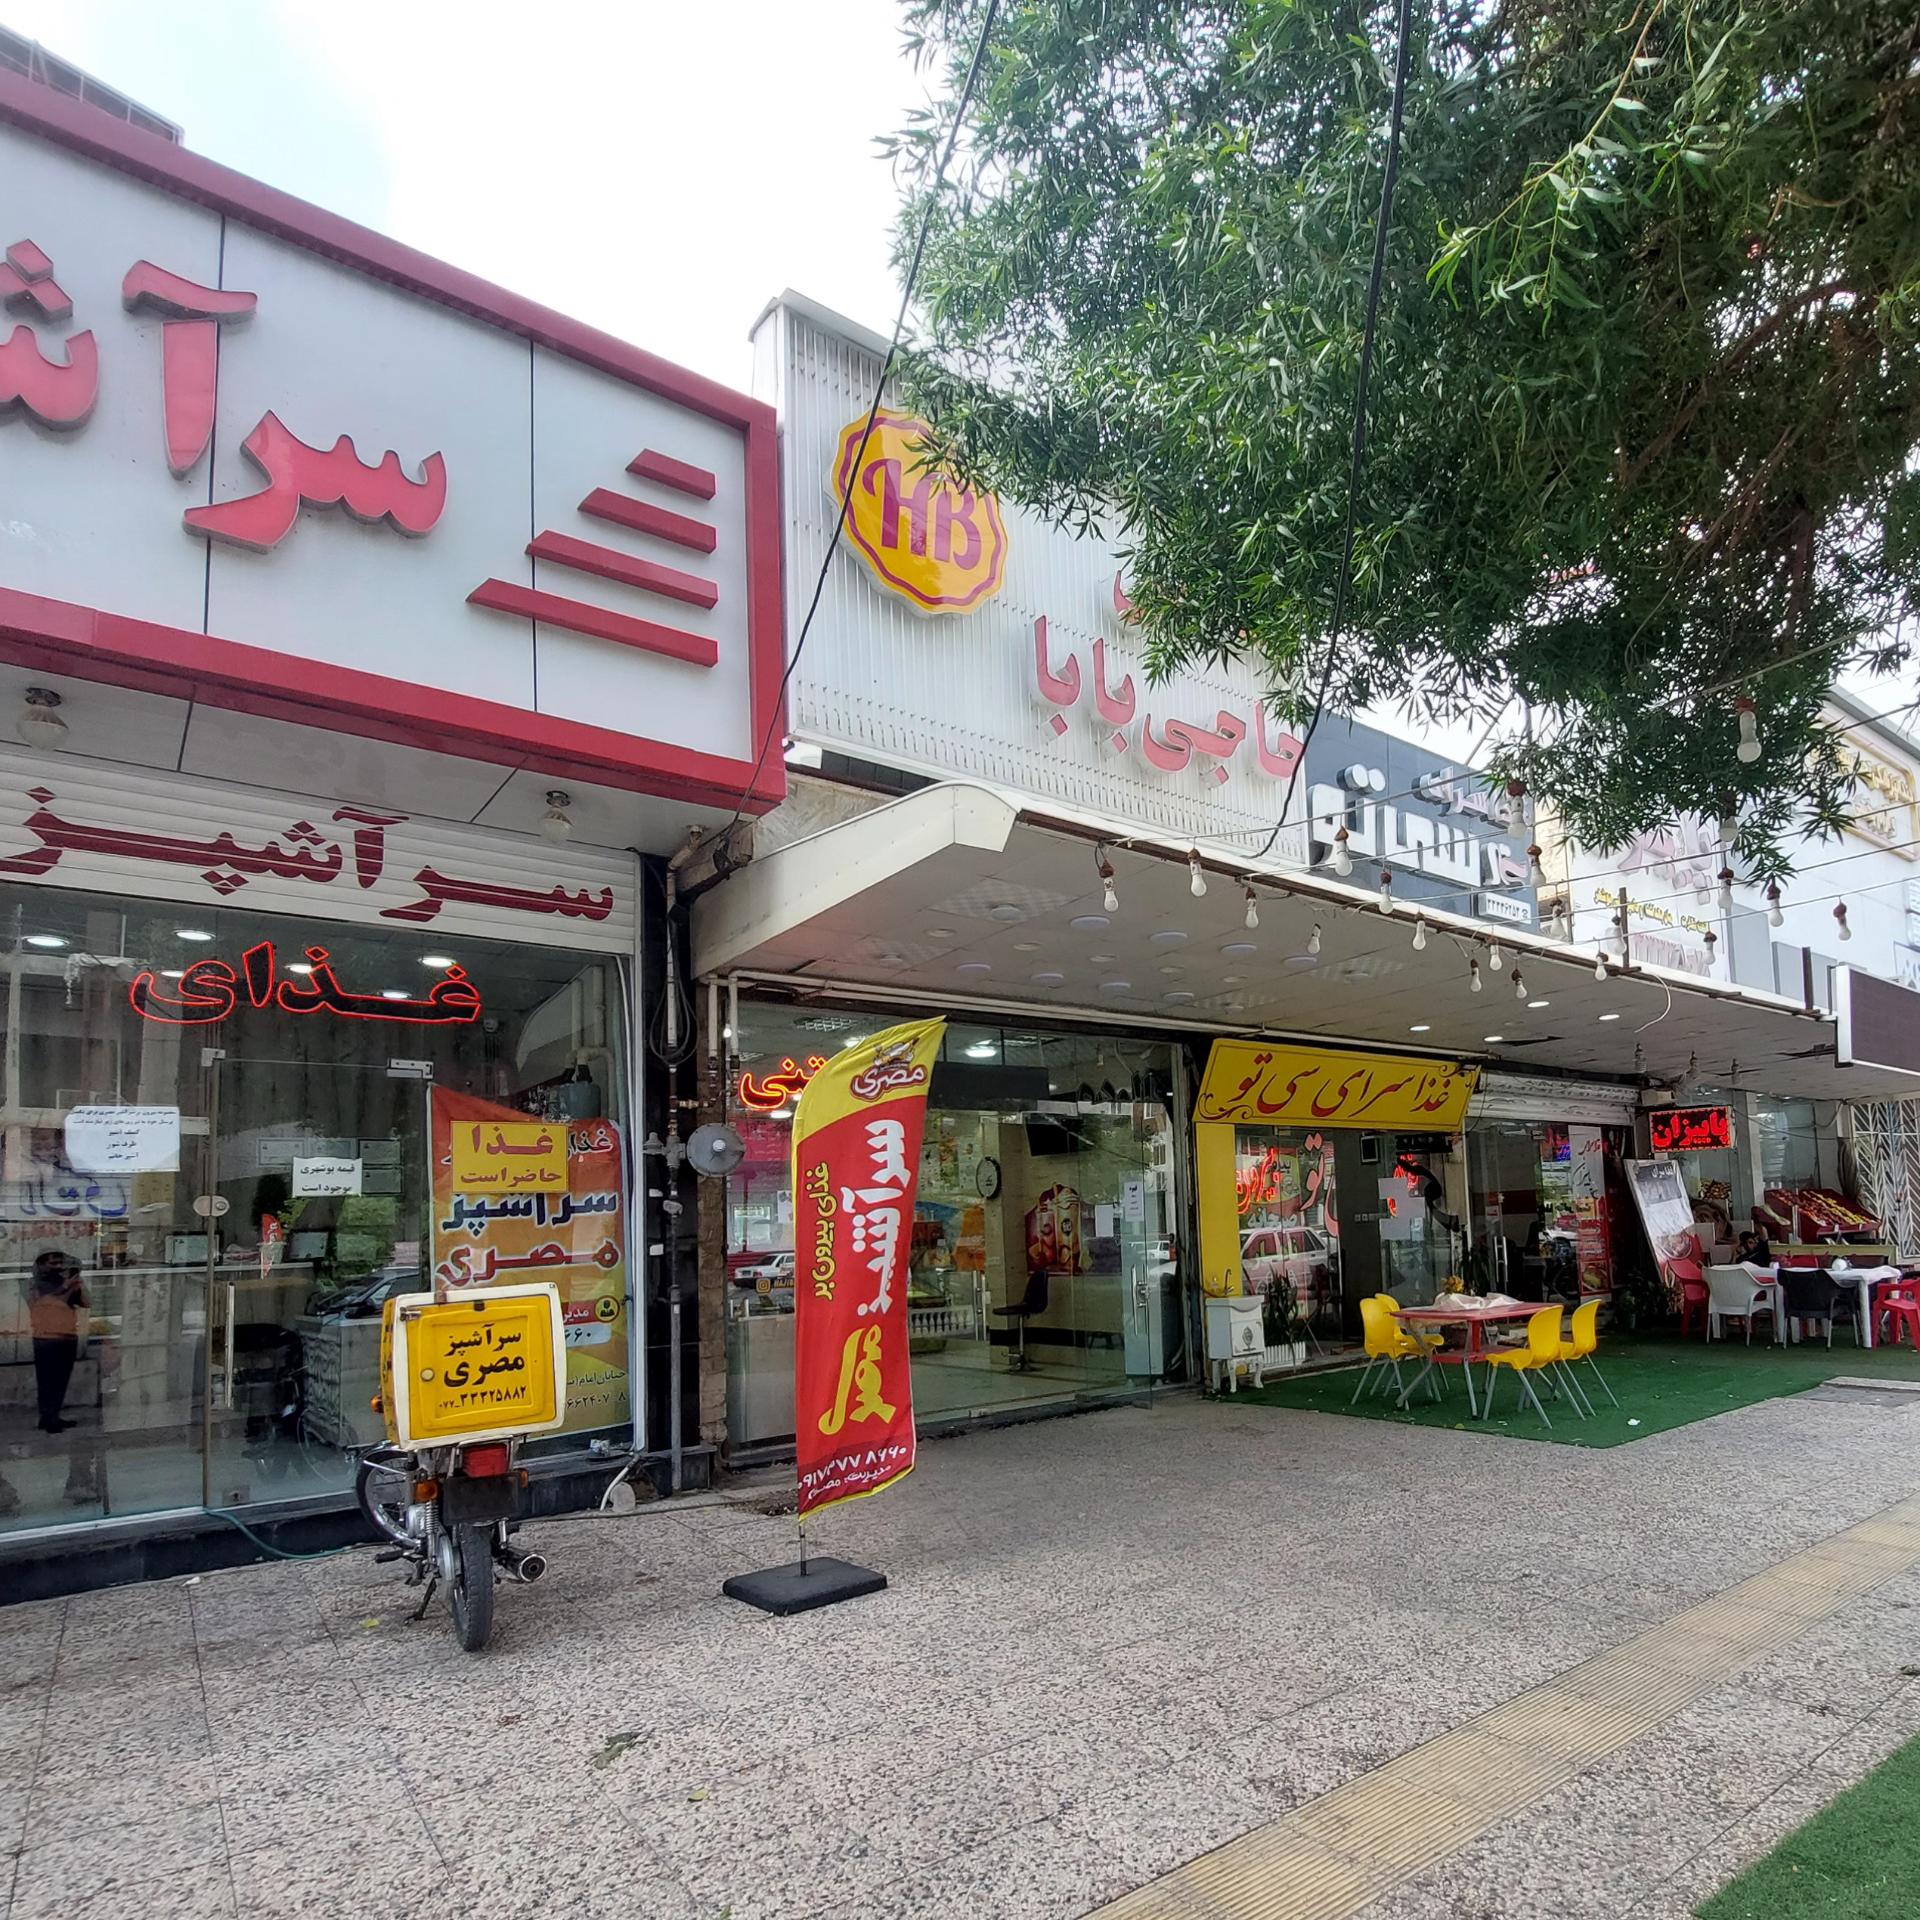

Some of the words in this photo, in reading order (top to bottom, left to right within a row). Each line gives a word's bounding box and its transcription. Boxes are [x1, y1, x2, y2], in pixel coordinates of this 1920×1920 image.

[862, 457, 981, 570] HB
[1032, 614, 1137, 755] بابا
[1141, 699, 1305, 785] حاجی
[130, 941, 482, 1024] غذای
[852, 1066, 926, 1098] مصری
[1226, 1051, 1273, 1103] تو
[471, 1124, 554, 1156] غذا
[460, 1167, 507, 1184] است
[507, 1167, 563, 1188] حاضر
[435, 1239, 620, 1288] مصری
[443, 1323, 522, 1357] سرآشپز
[443, 1354, 526, 1388] مصری
